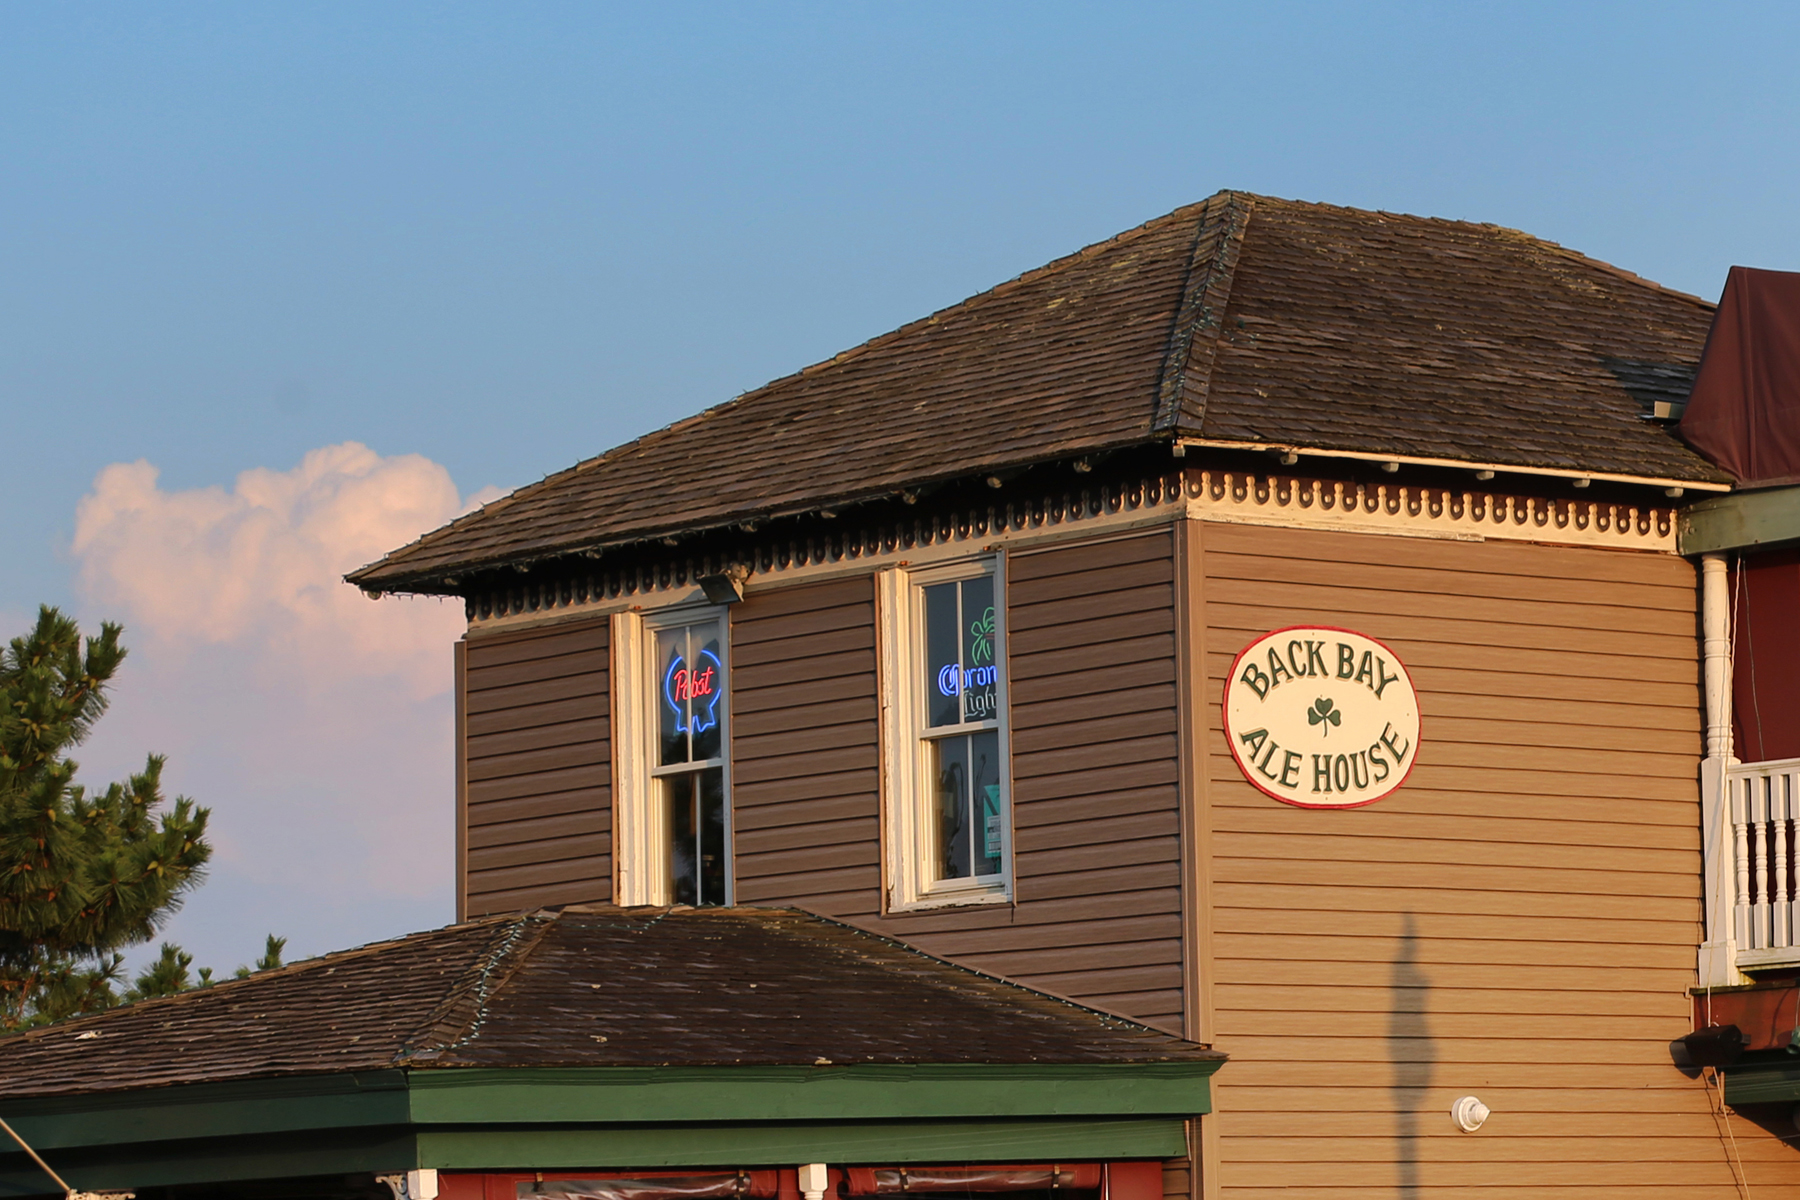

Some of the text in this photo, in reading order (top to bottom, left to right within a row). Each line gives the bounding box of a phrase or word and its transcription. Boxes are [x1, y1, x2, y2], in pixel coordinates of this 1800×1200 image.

[673, 665, 715, 702] Pabst
[938, 663, 998, 697] Coron
[1240, 639, 1399, 700] BACK BAY
[963, 686, 997, 717] Ligh
[1239, 721, 1410, 794] ALE HOUSE
